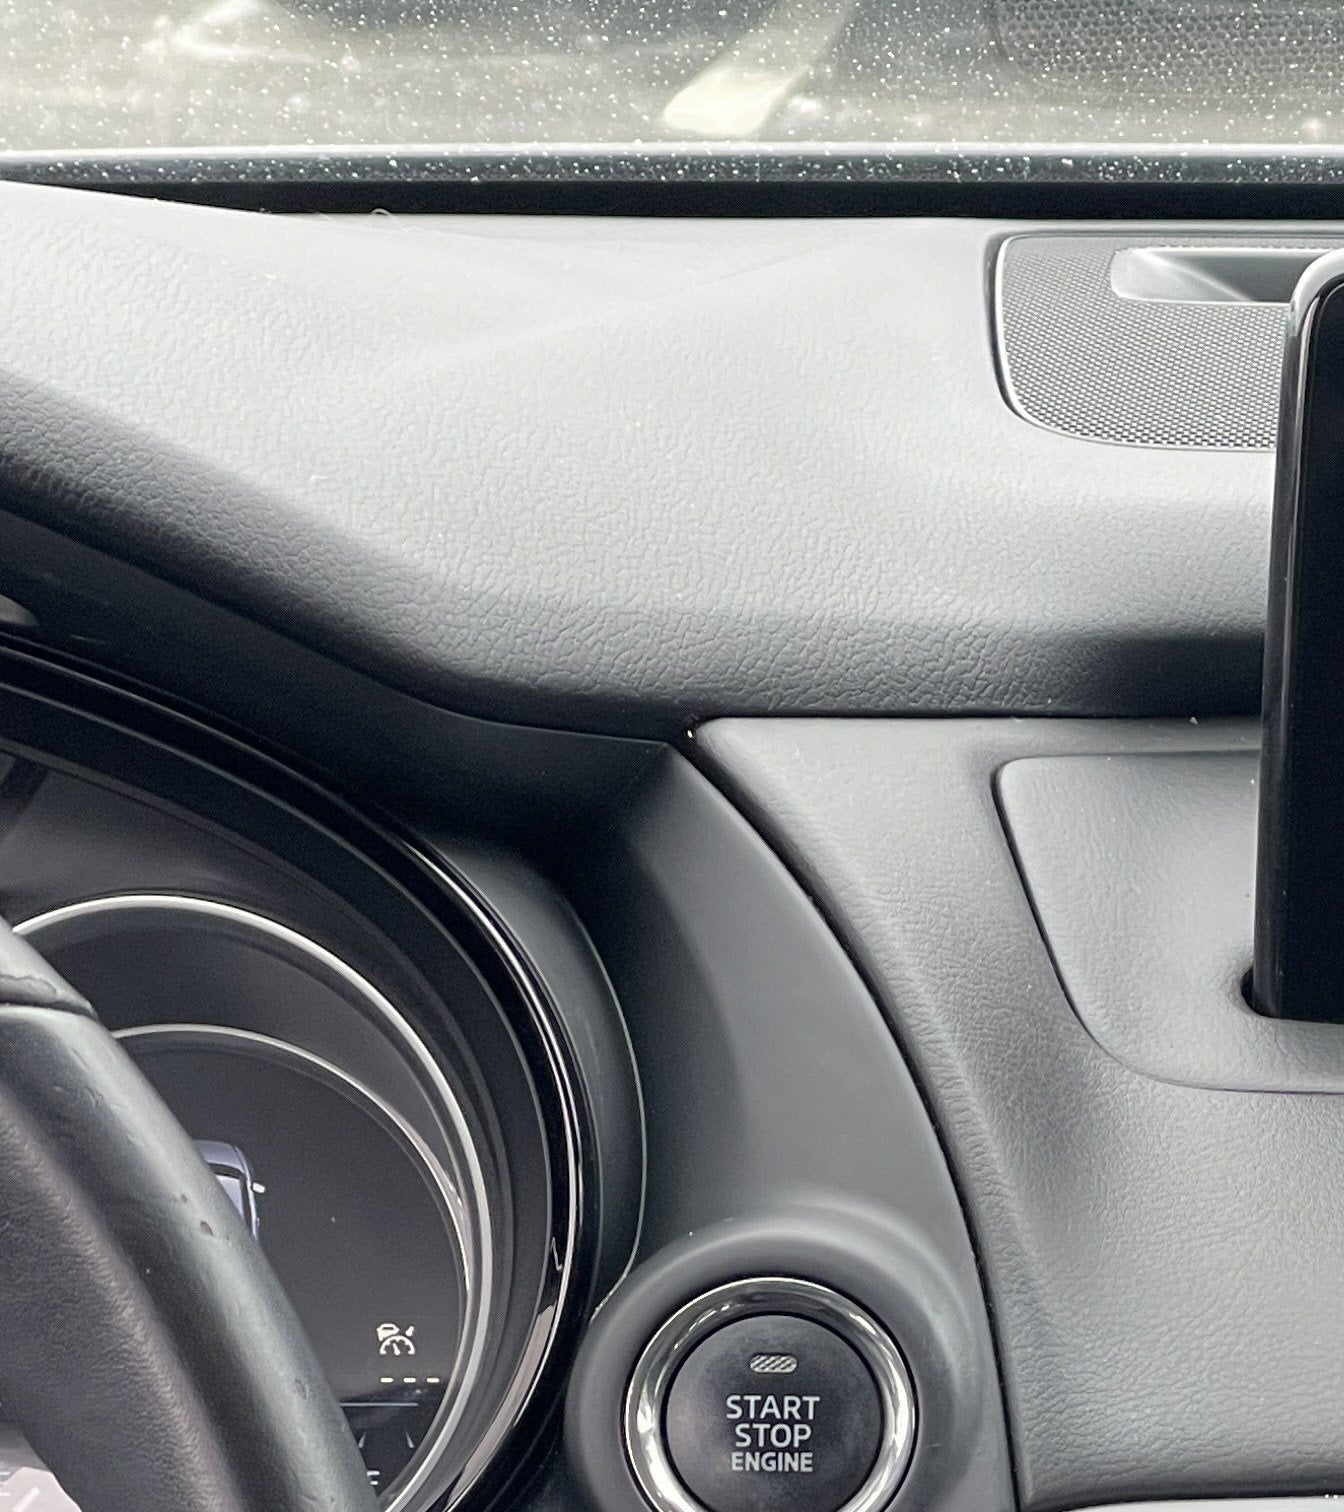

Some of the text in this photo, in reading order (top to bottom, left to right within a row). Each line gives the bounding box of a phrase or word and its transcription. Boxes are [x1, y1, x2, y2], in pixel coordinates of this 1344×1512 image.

[726, 1395, 821, 1420] START
[735, 1423, 812, 1448] STOP
[731, 1451, 814, 1473] ENGINE
